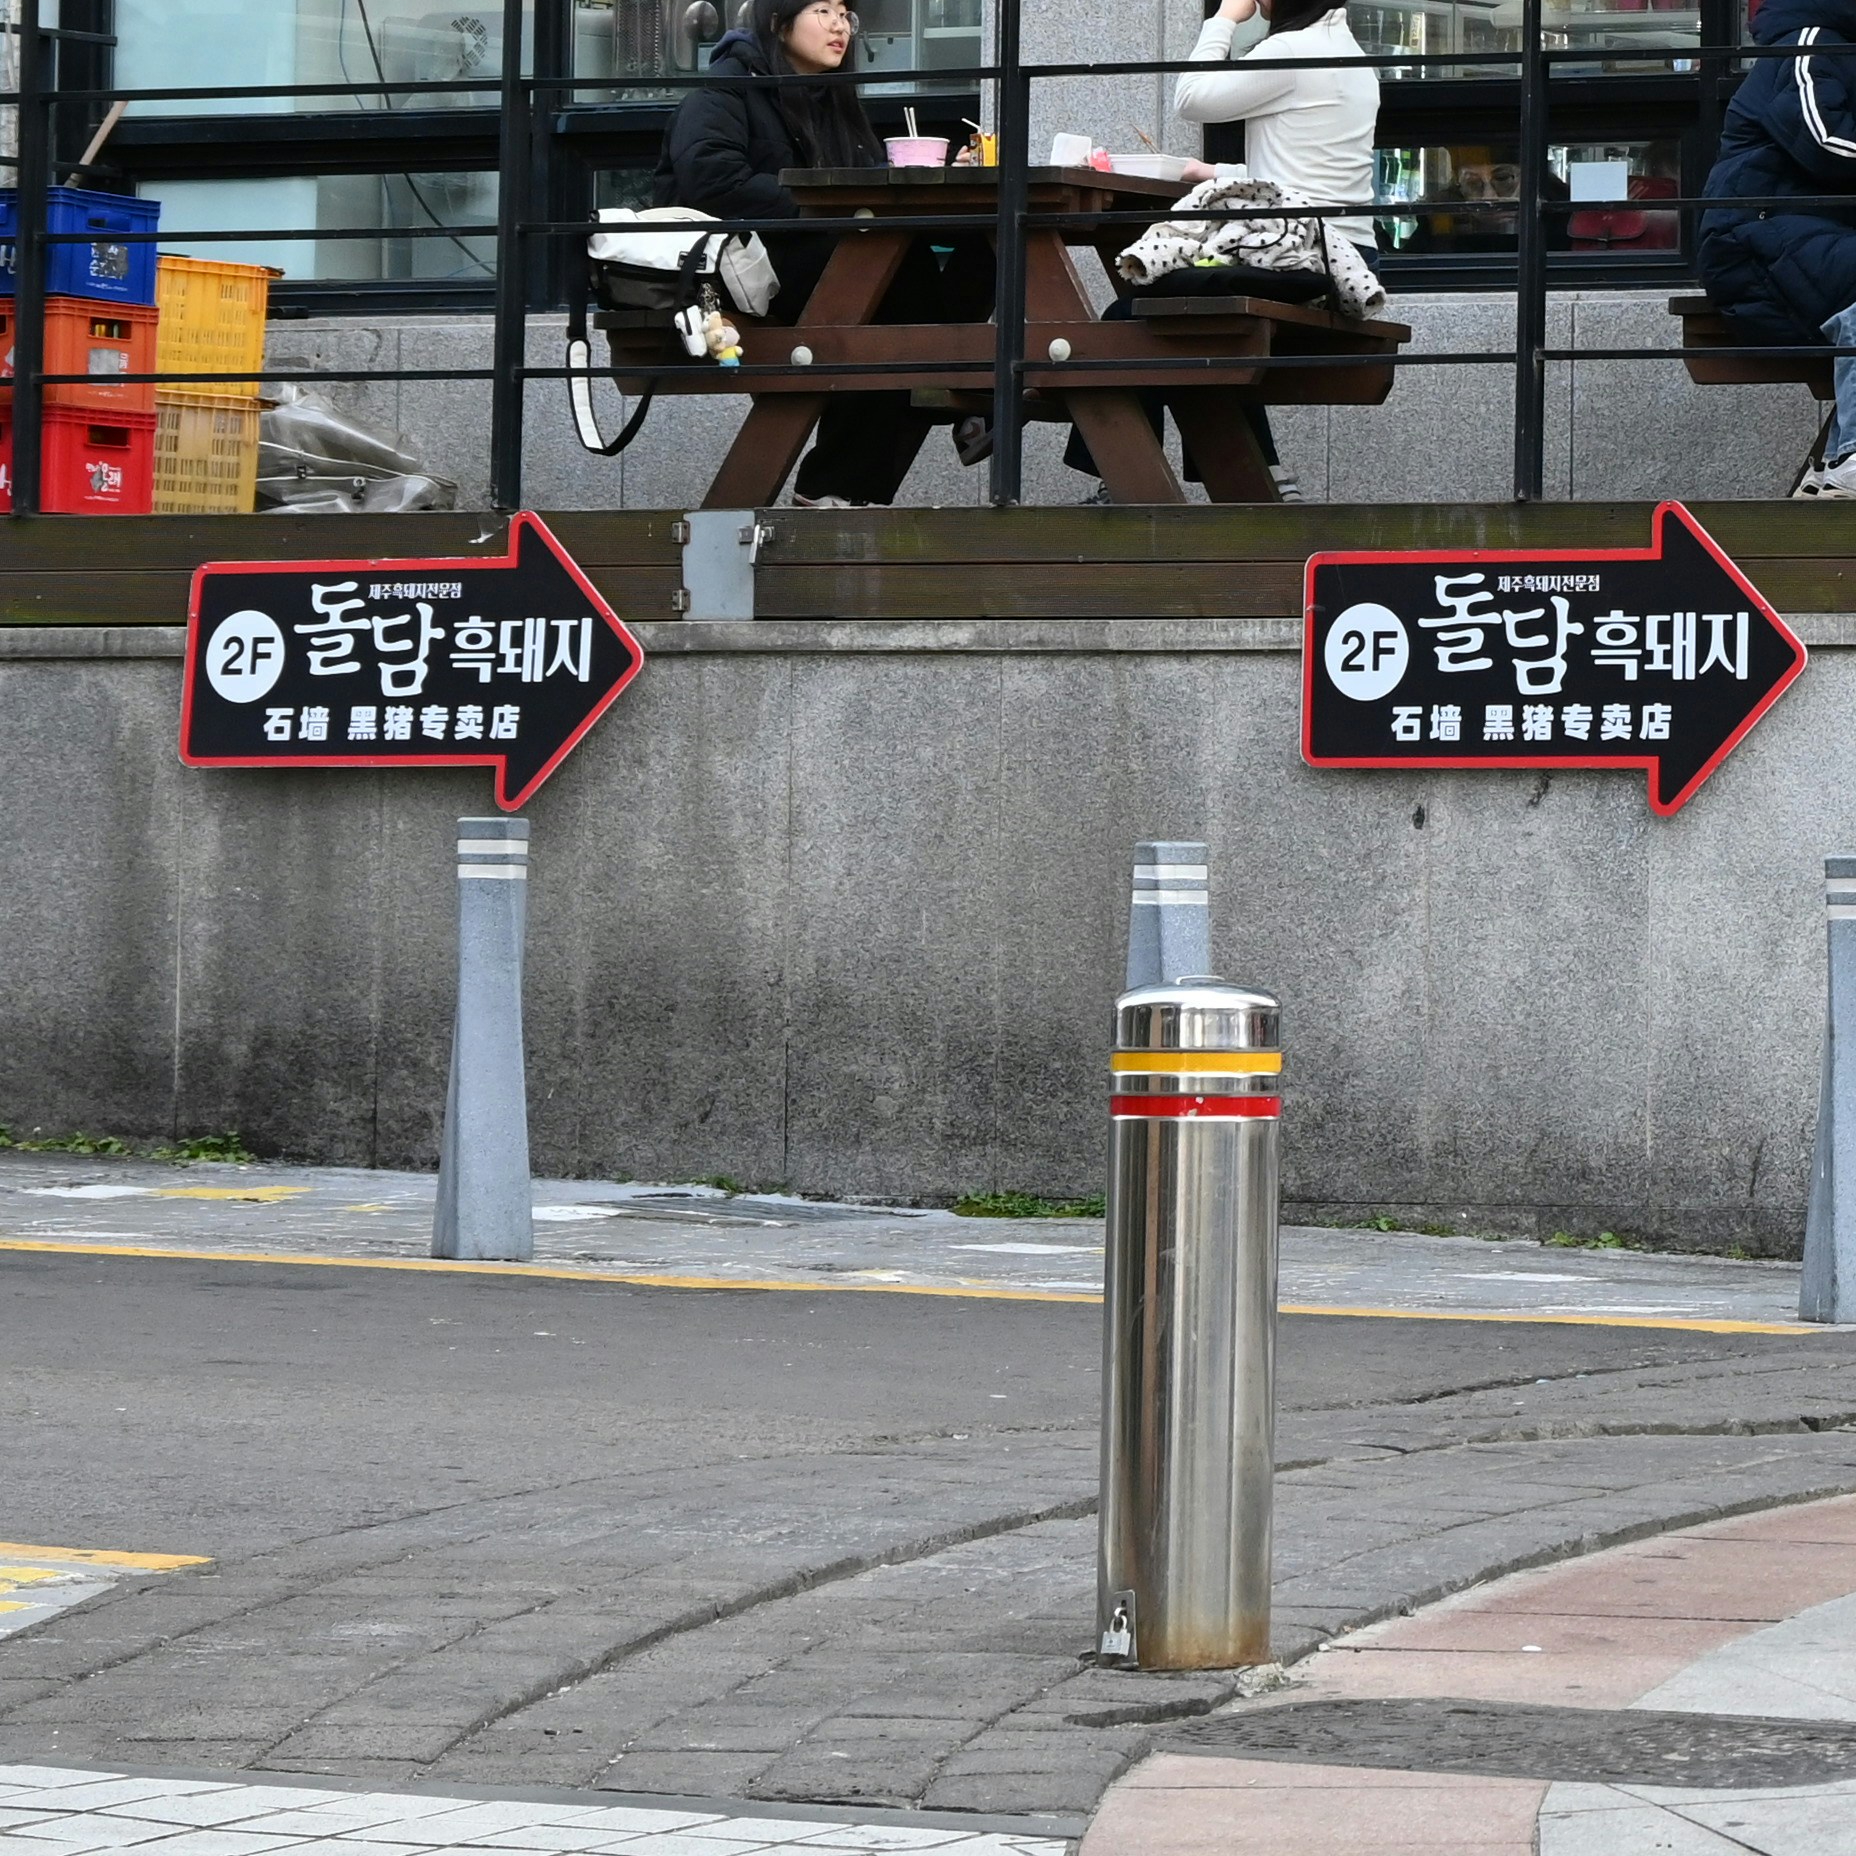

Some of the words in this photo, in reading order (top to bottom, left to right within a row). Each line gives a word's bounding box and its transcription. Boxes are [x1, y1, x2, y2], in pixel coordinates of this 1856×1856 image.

[368, 582, 461, 600] 제주흑돼지전문점
[1497, 574, 1600, 593] 제주흑돼지전문점
[221, 635, 275, 677] 2F
[294, 581, 445, 697] 돌담
[449, 615, 593, 683] 흑돼지
[1341, 630, 1398, 672] 2F
[1417, 573, 1583, 695] 돌담
[1590, 610, 1748, 681] 흑돼지
[263, 705, 329, 741] 石墙
[347, 704, 520, 740] 黑猪专卖店
[1391, 705, 1462, 742] 石墙
[1483, 703, 1672, 741] 黑猪专卖店
